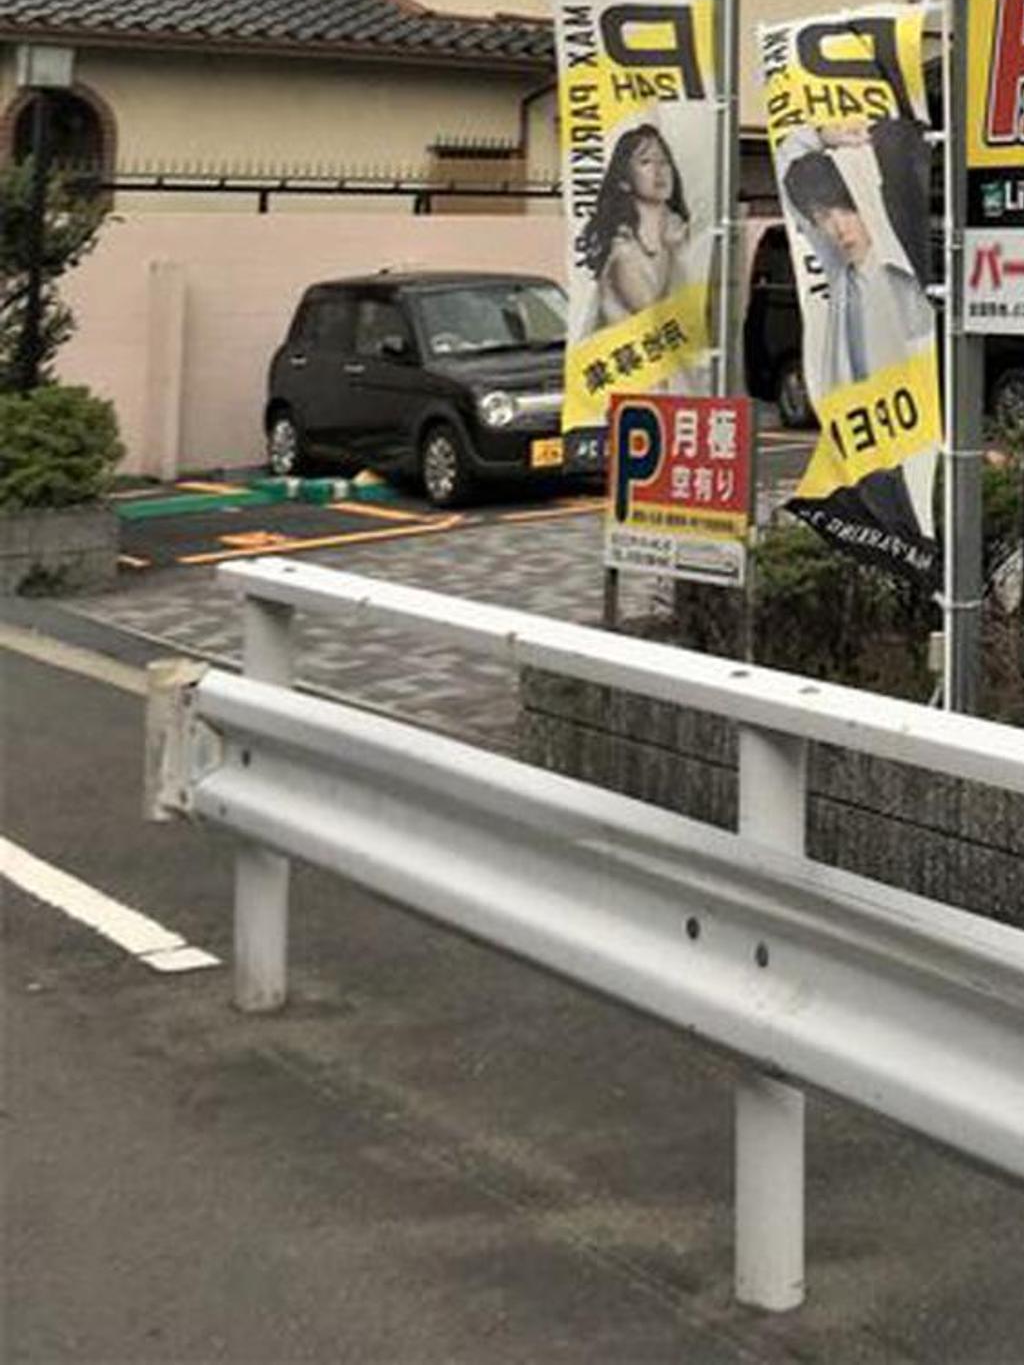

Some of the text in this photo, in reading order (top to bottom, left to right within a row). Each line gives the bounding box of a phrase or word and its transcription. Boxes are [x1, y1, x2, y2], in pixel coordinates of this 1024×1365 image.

[672, 408, 737, 460] 月極
[616, 402, 665, 523] P
[669, 465, 736, 502] 空有り
